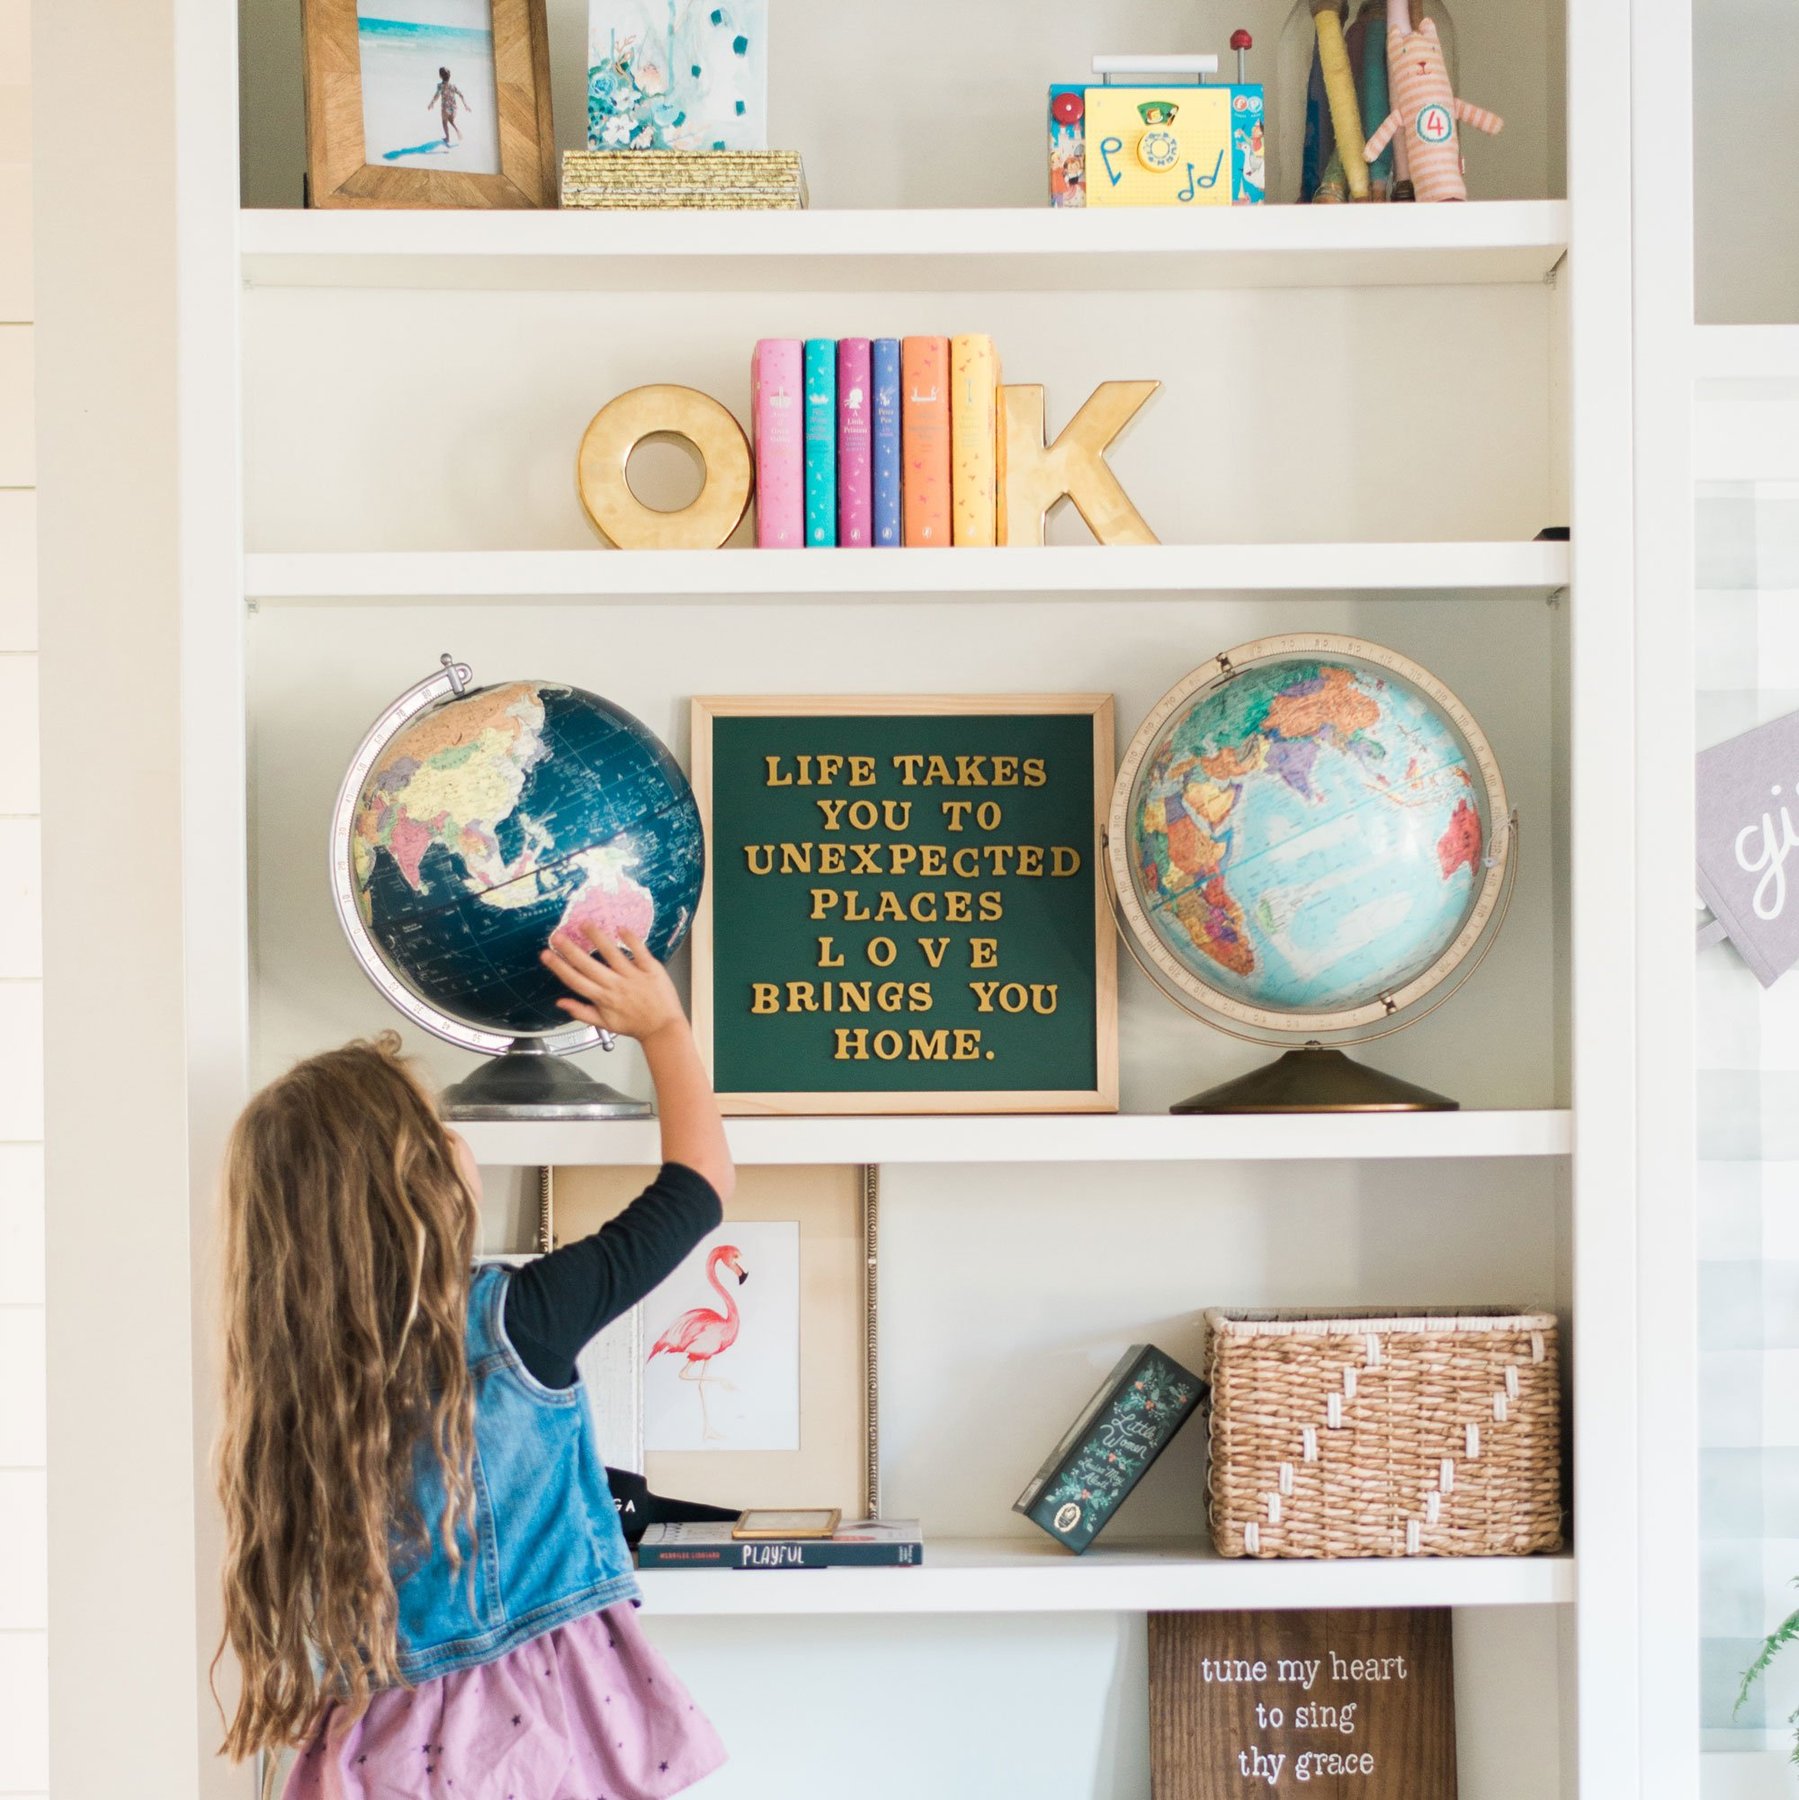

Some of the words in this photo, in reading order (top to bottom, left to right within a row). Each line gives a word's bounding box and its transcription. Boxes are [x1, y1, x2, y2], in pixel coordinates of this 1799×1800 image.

[765, 755, 876, 787] LIFE
[893, 755, 1047, 787] TAKES
[817, 800, 912, 831] YOU
[942, 801, 1002, 832] TO
[744, 843, 1081, 878] UNEXPECTED
[1735, 783, 1799, 920] gi
[810, 888, 1003, 922] PLACES
[751, 981, 934, 1014] BRINGS
[969, 981, 1058, 1014] YOU
[834, 1028, 995, 1061] HOME.
[1100, 1424, 1147, 1459] Women
[1112, 1414, 1156, 1441] Little
[742, 1544, 804, 1566] PLAYFUL
[1202, 1657, 1267, 1682] tune
[1277, 1659, 1320, 1690] my
[1329, 1651, 1407, 1681] heart
[1256, 1702, 1283, 1729] to
[1295, 1701, 1357, 1734] sing
[1239, 1746, 1286, 1785] thy
[1295, 1751, 1374, 1781] grace
